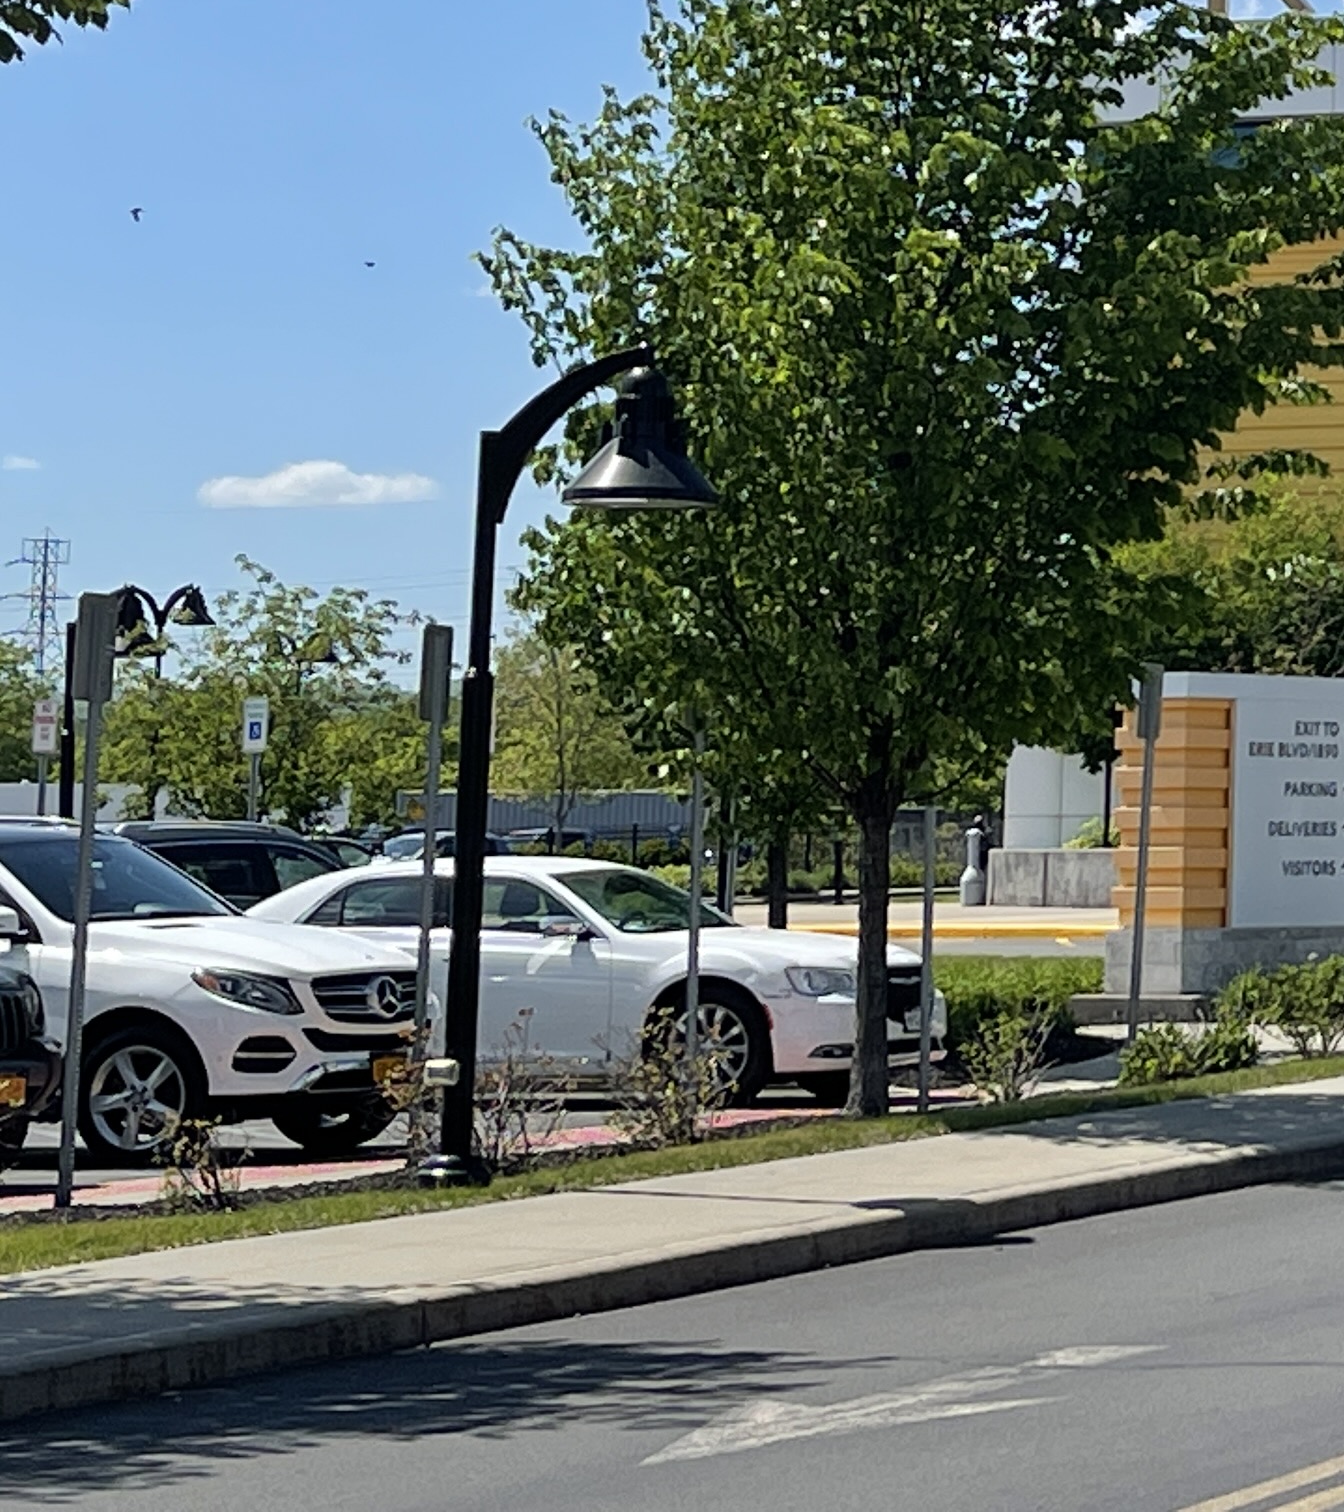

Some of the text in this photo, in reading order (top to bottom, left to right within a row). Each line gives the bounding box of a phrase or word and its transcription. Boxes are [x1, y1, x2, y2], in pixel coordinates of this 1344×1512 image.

[1294, 720, 1340, 737] EXIT TO
[1283, 780, 1338, 798] PARKING
[1267, 820, 1337, 837] DELIVERIES
[1281, 859, 1336, 877] VISITORS
